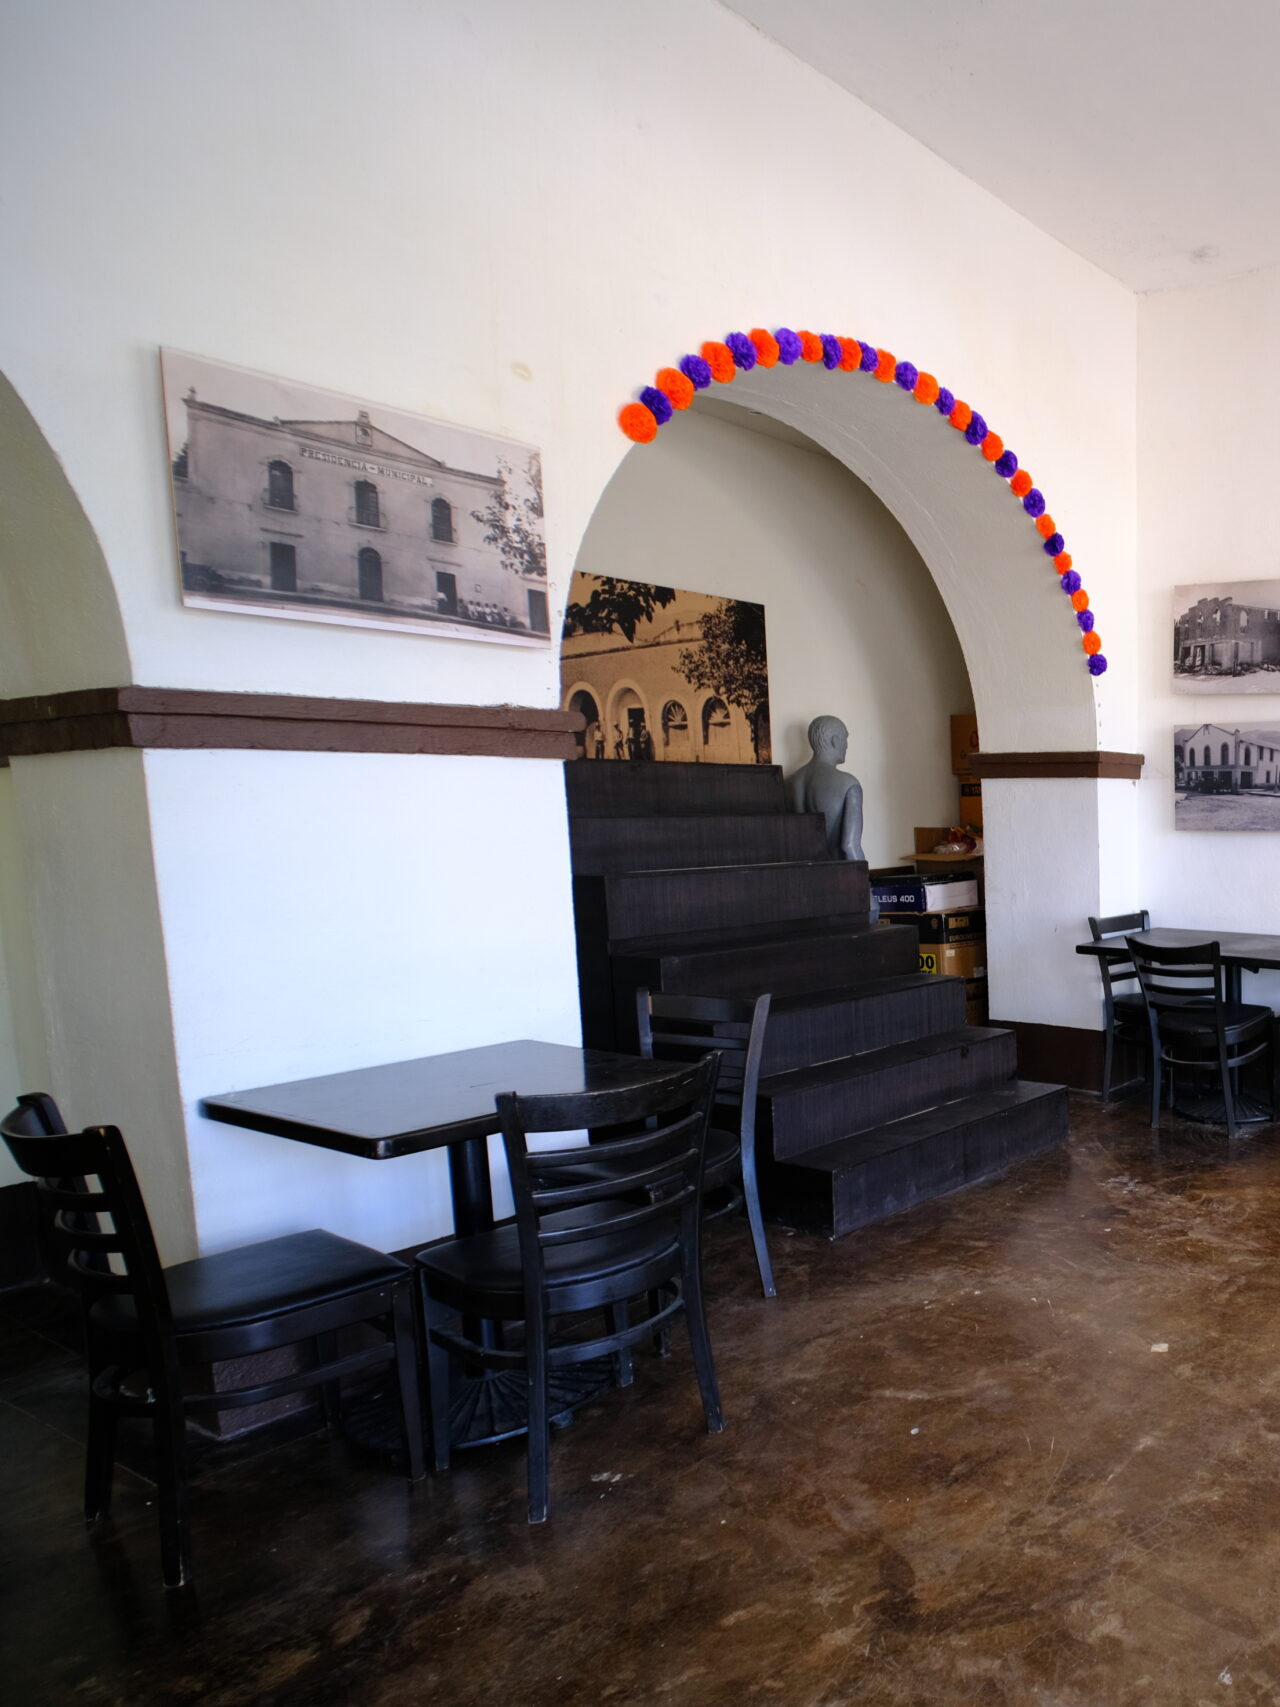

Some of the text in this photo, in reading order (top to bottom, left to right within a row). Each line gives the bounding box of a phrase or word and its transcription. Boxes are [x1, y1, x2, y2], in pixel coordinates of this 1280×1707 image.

[300, 447, 367, 471] PRESIDENCIA
[873, 894, 915, 903] LEUS 400
